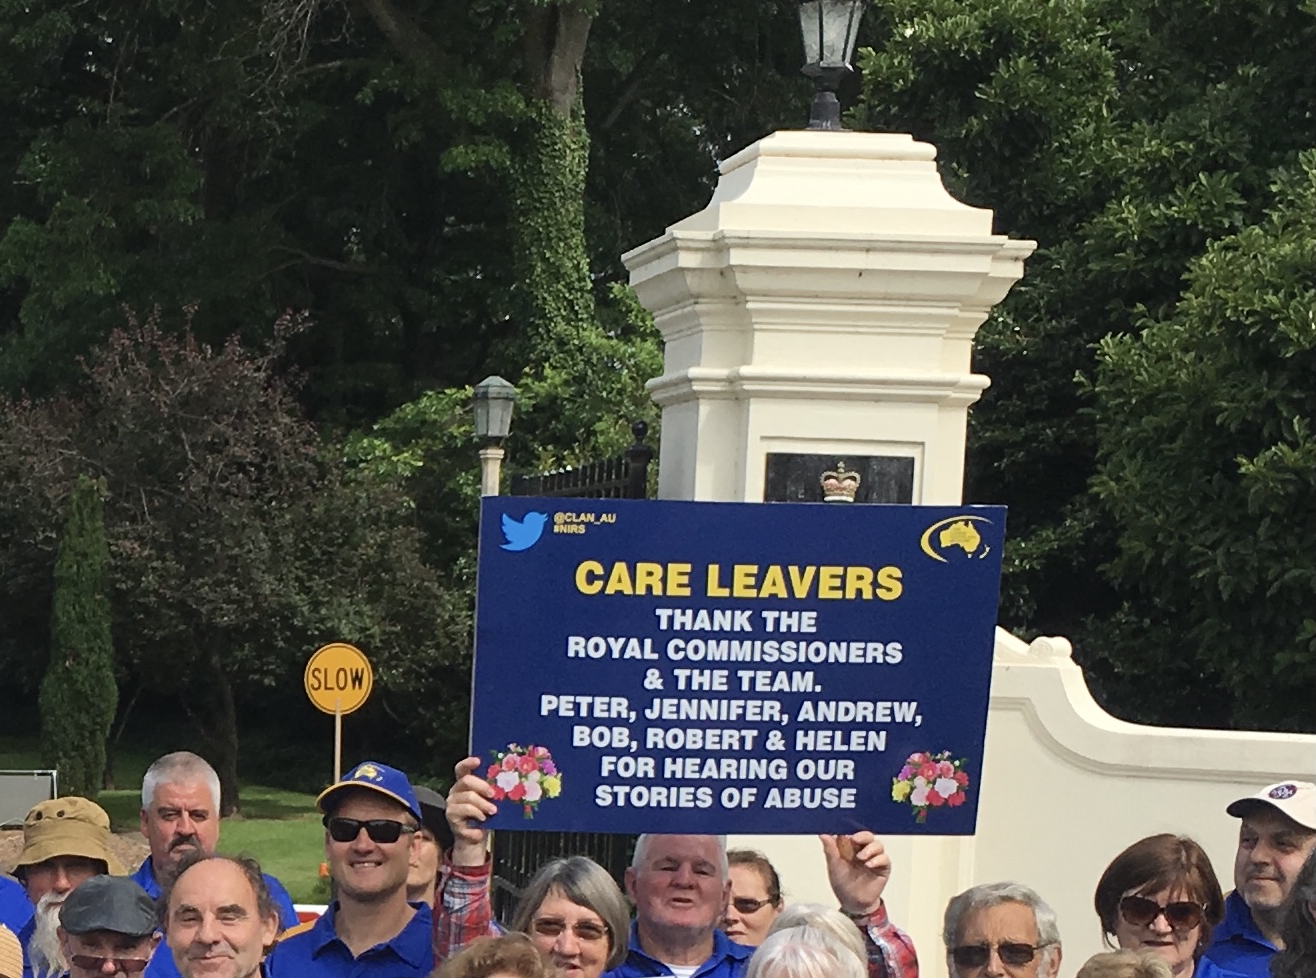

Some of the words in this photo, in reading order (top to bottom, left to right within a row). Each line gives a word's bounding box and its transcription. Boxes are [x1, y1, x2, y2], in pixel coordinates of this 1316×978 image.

[553, 512, 616, 525] @CLAN_AU
[553, 523, 586, 535] #NIRS
[575, 561, 692, 596] CARE
[707, 564, 903, 600] LEAVERS
[655, 608, 753, 633] THANK
[762, 610, 817, 633] THE
[567, 637, 659, 661] ROYAL
[667, 638, 903, 664] COMMISSIONERS
[310, 667, 364, 691] SLOW
[644, 668, 664, 691] &
[674, 668, 730, 691] THE
[738, 670, 822, 694] TEAM.
[540, 695, 636, 723] PETER,
[644, 698, 789, 726] JENNIFER,
[797, 701, 923, 728] ANDREW,
[573, 726, 638, 753] BOB,
[646, 727, 758, 751] ROBERT
[766, 729, 786, 752] &
[796, 730, 886, 752] HELEN
[601, 756, 656, 780] FOR
[664, 757, 788, 781] HEARING
[796, 758, 854, 781] OUR
[595, 785, 713, 809] STORIES
[721, 786, 756, 809] OF
[764, 787, 857, 810] ABUSE
